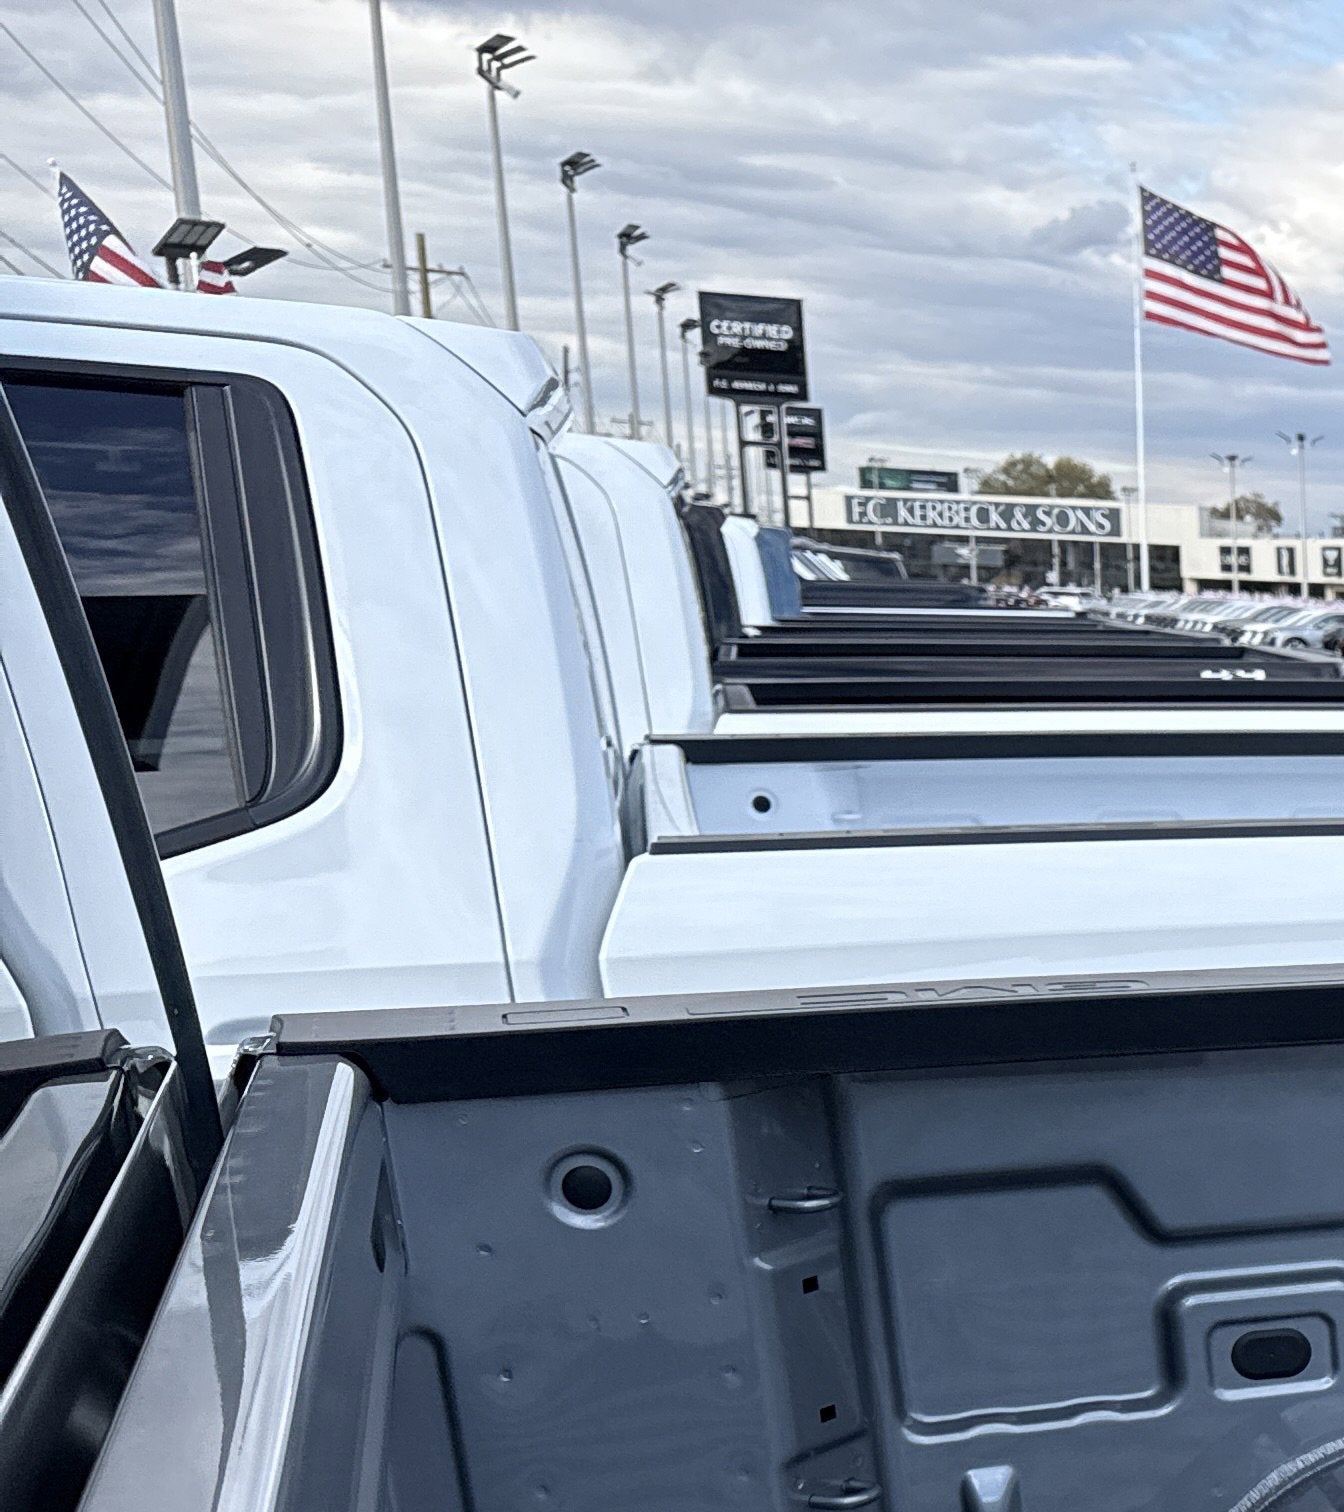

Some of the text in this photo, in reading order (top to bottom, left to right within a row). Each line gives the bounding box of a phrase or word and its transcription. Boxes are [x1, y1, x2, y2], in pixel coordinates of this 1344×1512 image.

[709, 318, 794, 340] CERTIFIED
[717, 335, 788, 352] PRE-OWNED
[850, 496, 1114, 536] F.C. KERBECK & SONS
